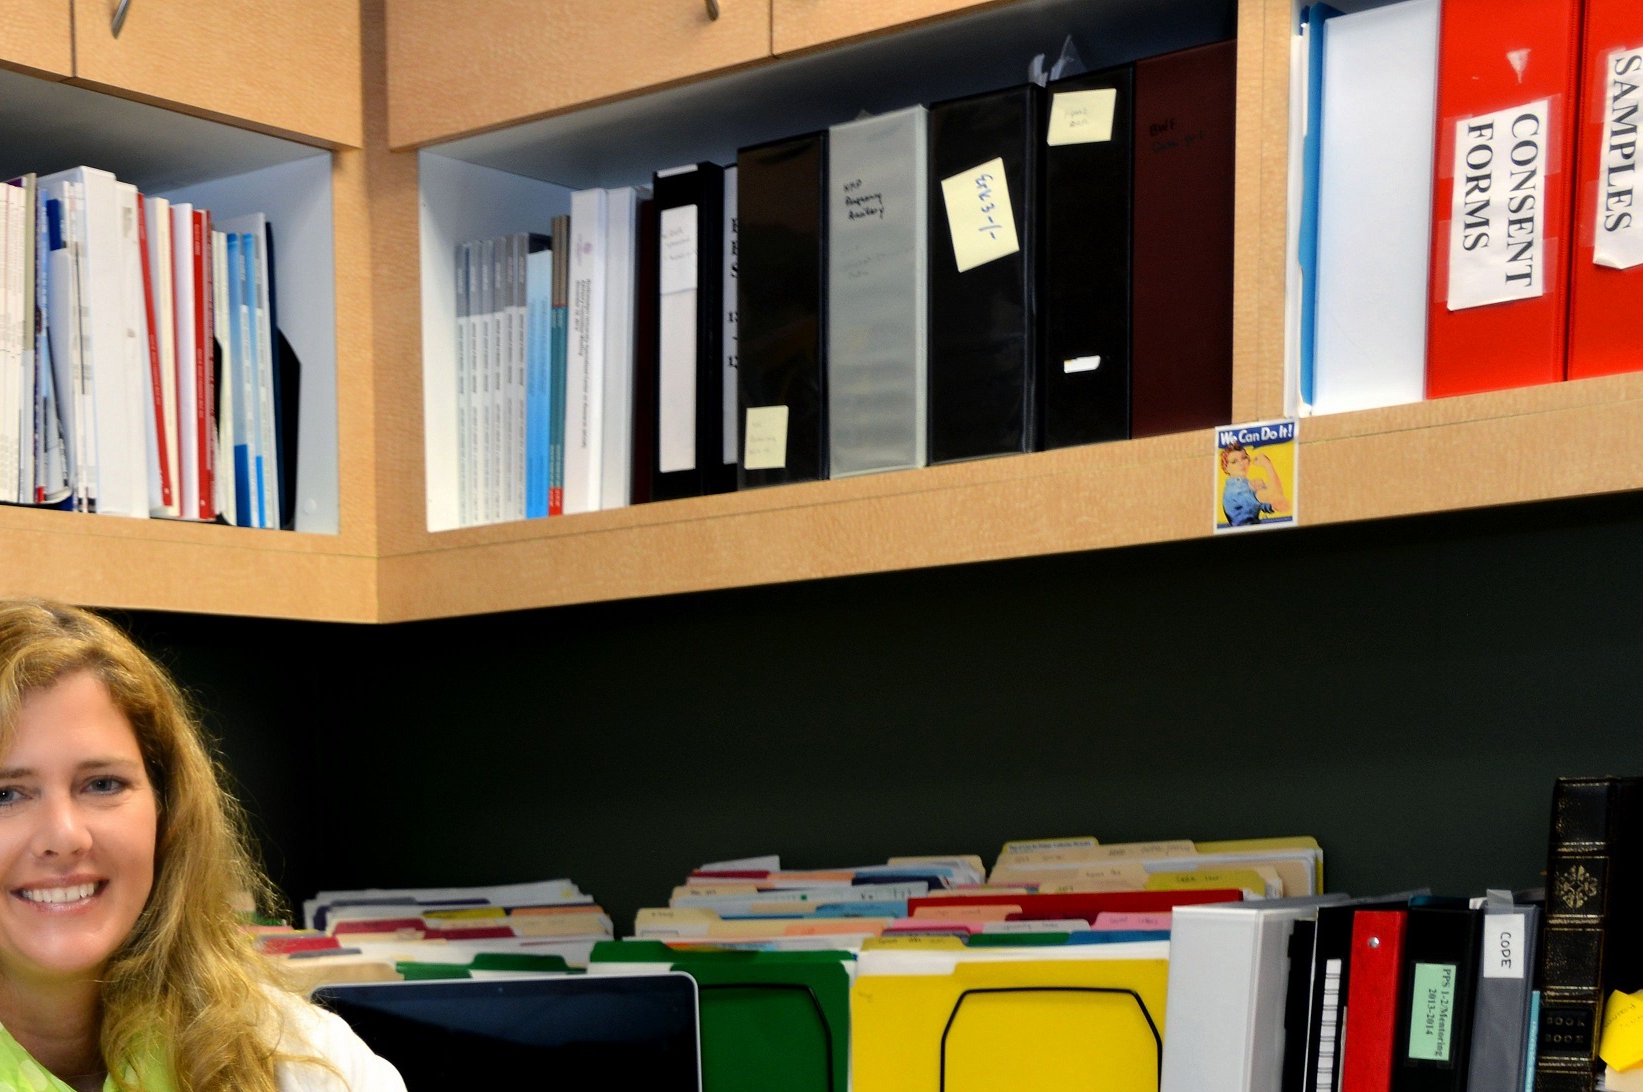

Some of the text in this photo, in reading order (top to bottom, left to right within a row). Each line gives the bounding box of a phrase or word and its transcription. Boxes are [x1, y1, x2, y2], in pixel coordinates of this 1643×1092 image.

[1462, 119, 1495, 252] FORMS
[1604, 54, 1642, 232] SAMPLES
[1506, 113, 1540, 288] CONSENT
[1220, 424, 1293, 446] We Can Do It!
[1500, 932, 1512, 968] CODE
[1424, 988, 1437, 1036] 2013-2014
